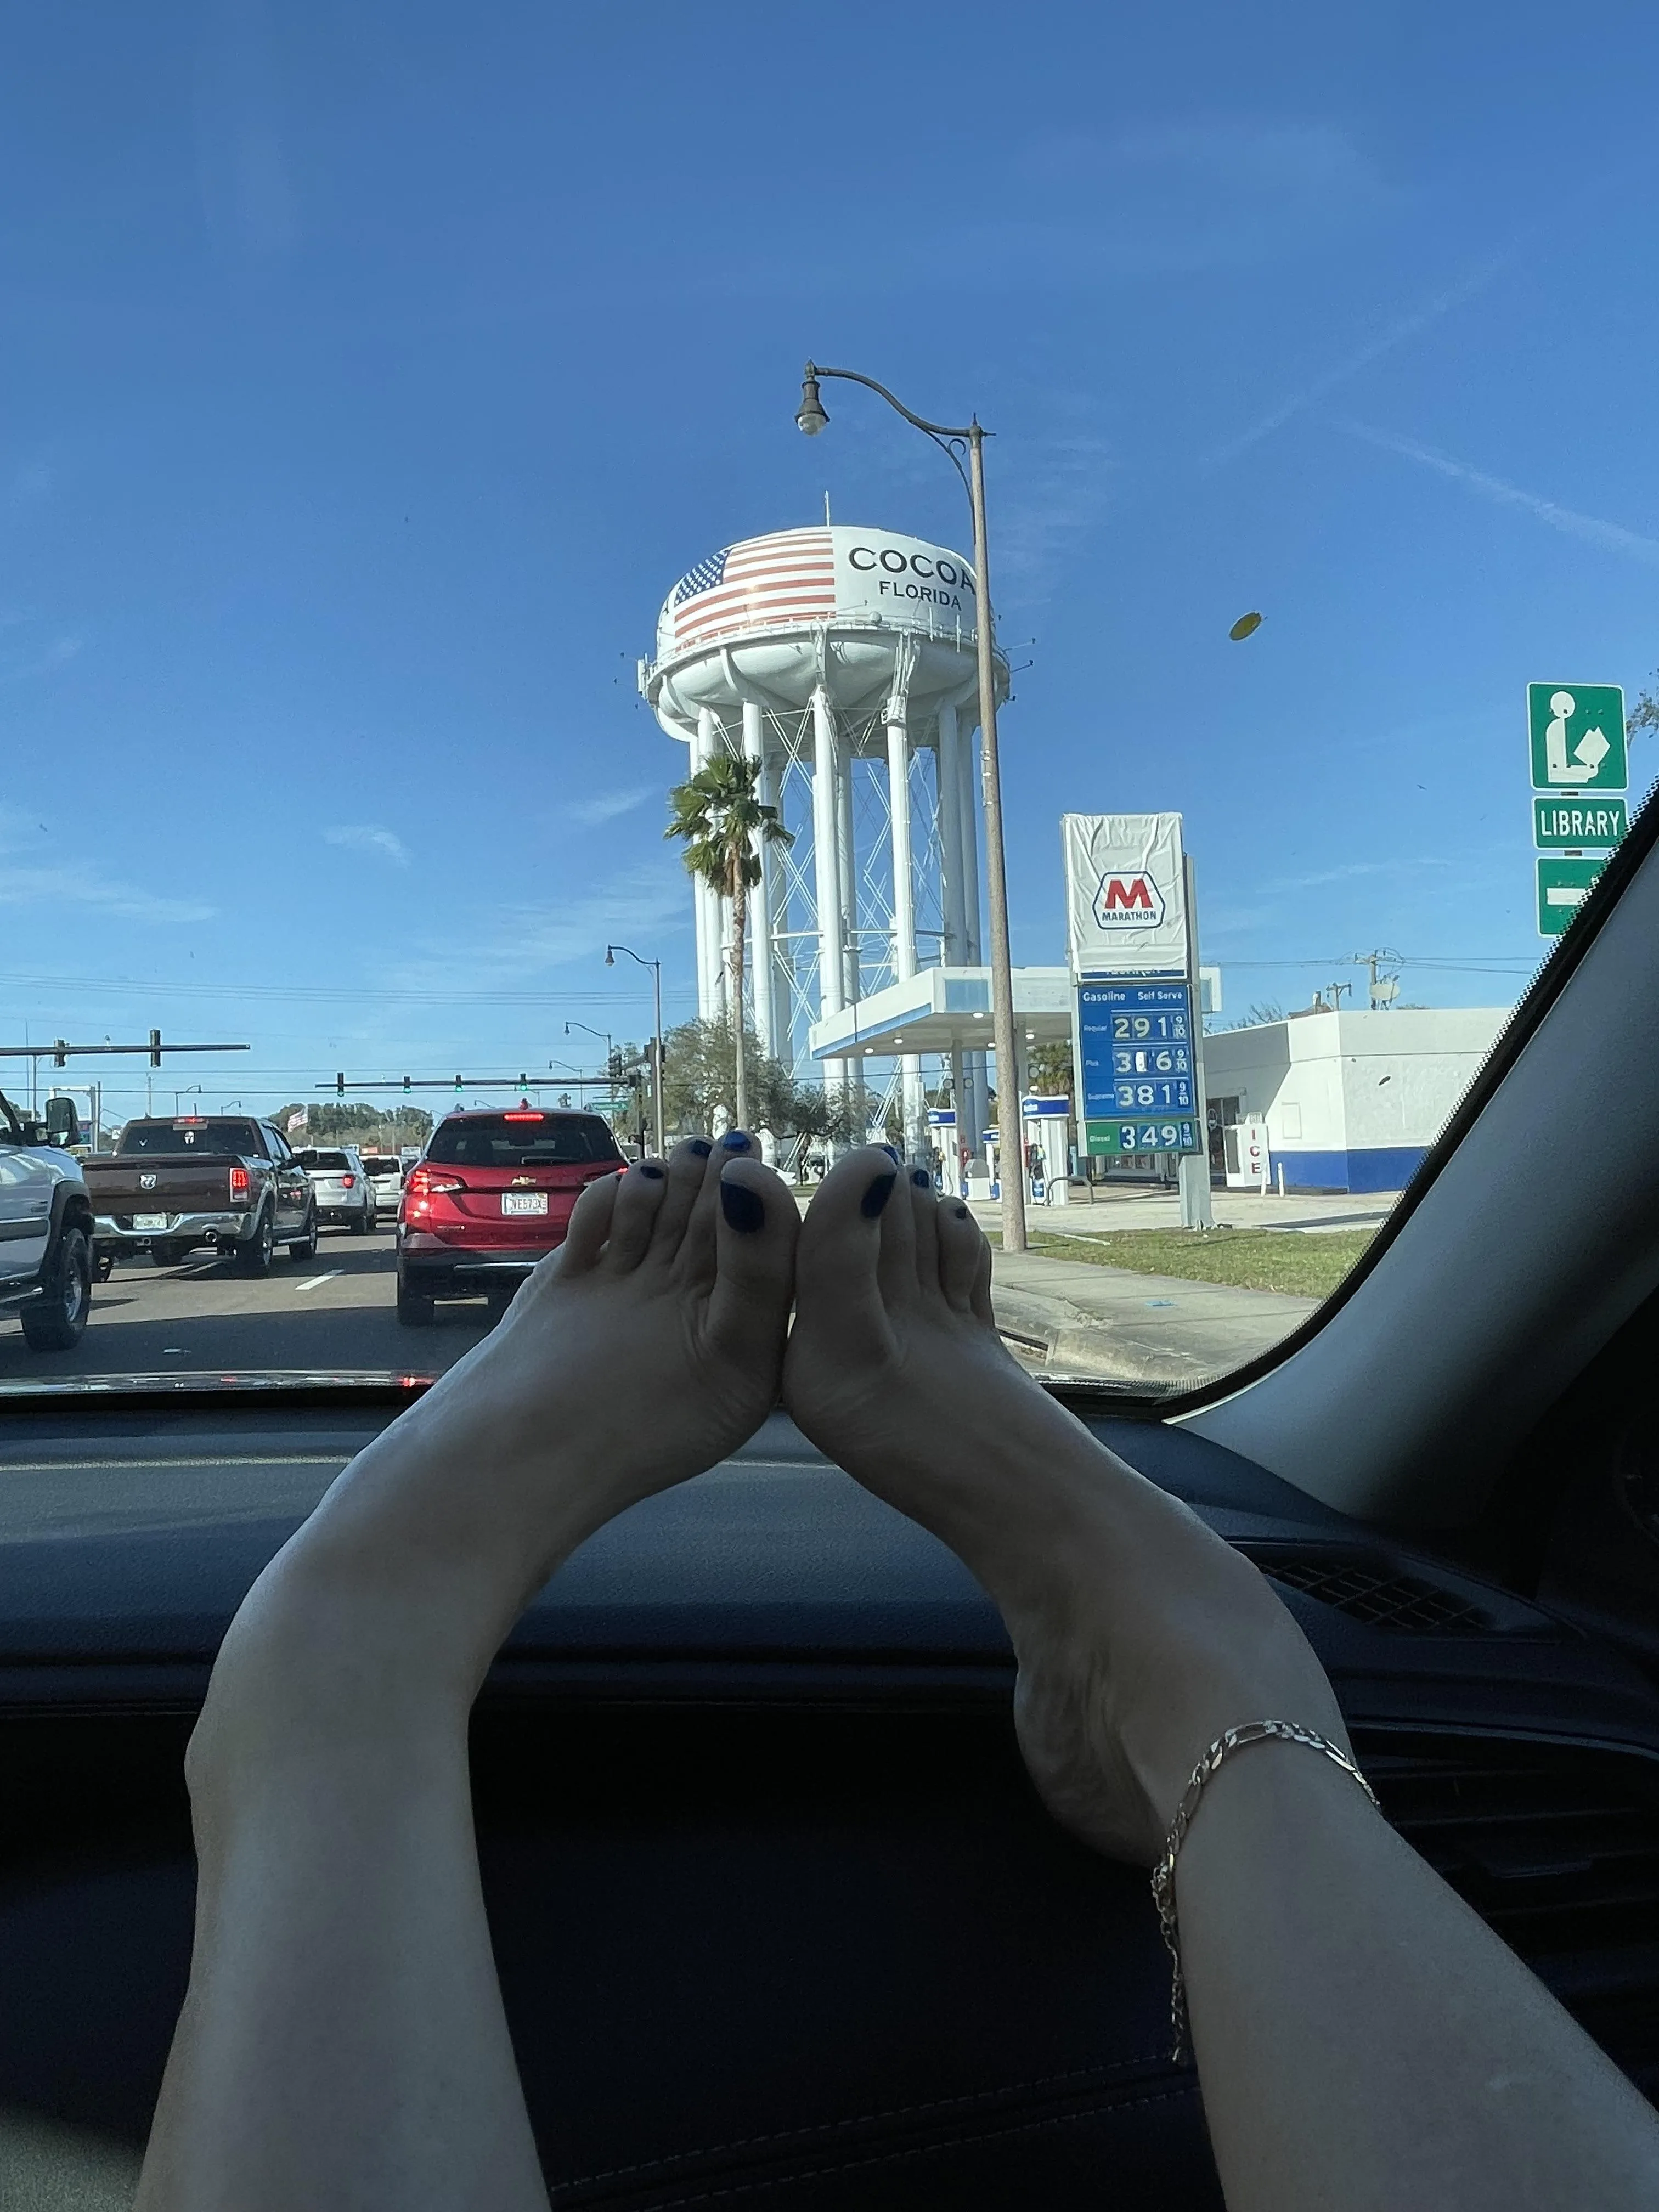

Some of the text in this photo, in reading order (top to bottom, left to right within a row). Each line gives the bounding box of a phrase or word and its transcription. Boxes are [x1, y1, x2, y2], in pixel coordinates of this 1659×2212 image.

[849, 547, 976, 596] COCOA
[879, 580, 962, 611] FLORIDA
[1541, 810, 1620, 836] LIBRARY
[1104, 879, 1154, 909] M
[1102, 911, 1156, 921] MARATHON
[1083, 991, 1183, 1002] Gasoline Self Serve
[1121, 1126, 1177, 1149] 349
[1250, 1129, 1262, 1174] ICE
